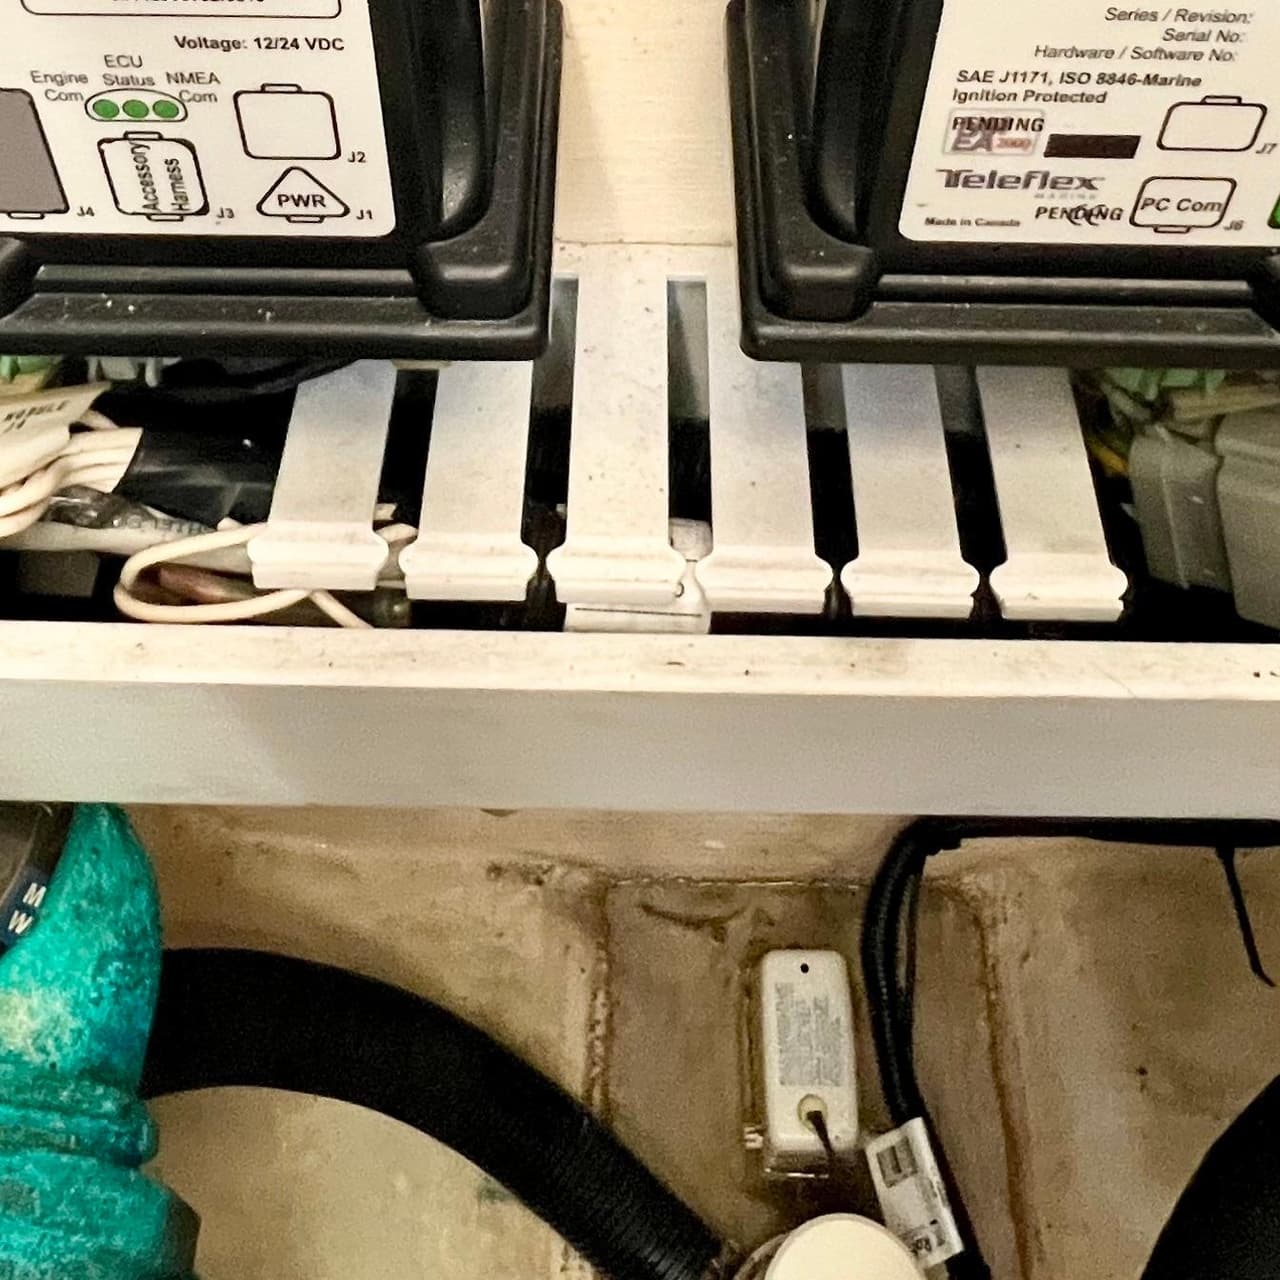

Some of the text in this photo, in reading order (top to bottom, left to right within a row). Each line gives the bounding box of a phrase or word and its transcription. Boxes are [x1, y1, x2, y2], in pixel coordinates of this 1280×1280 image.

[1104, 6, 1159, 22] Series
[1173, 8, 1255, 25] Revision:
[1161, 27, 1247, 43] Serial No:
[173, 35, 346, 53] Voltage: 12/24 VDC
[1034, 44, 1115, 60] Hardware
[1130, 45, 1205, 61] Software
[1208, 47, 1239, 62] No:
[103, 54, 144, 69] ECU
[29, 70, 89, 87] Engine
[102, 73, 157, 87] Status
[165, 71, 222, 86] NMEA
[956, 70, 1203, 88] SAE J1171, ISO 8846-Marine
[44, 88, 86, 103] Com
[178, 89, 218, 104] Com
[951, 88, 1108, 104] Ignition Protected
[1255, 142, 1278, 156] J7
[347, 151, 367, 164] J2
[128, 141, 161, 213] Accessory
[935, 168, 1106, 191] Teleflex
[164, 158, 191, 212] Harness
[277, 193, 328, 208] PWR
[1139, 197, 1223, 213] PC Com
[76, 206, 95, 218] J4
[216, 207, 235, 219] J3
[355, 208, 373, 221] J1
[924, 216, 958, 226] Made
[974, 217, 1021, 227] Canada
[1223, 220, 1245, 232] J6
